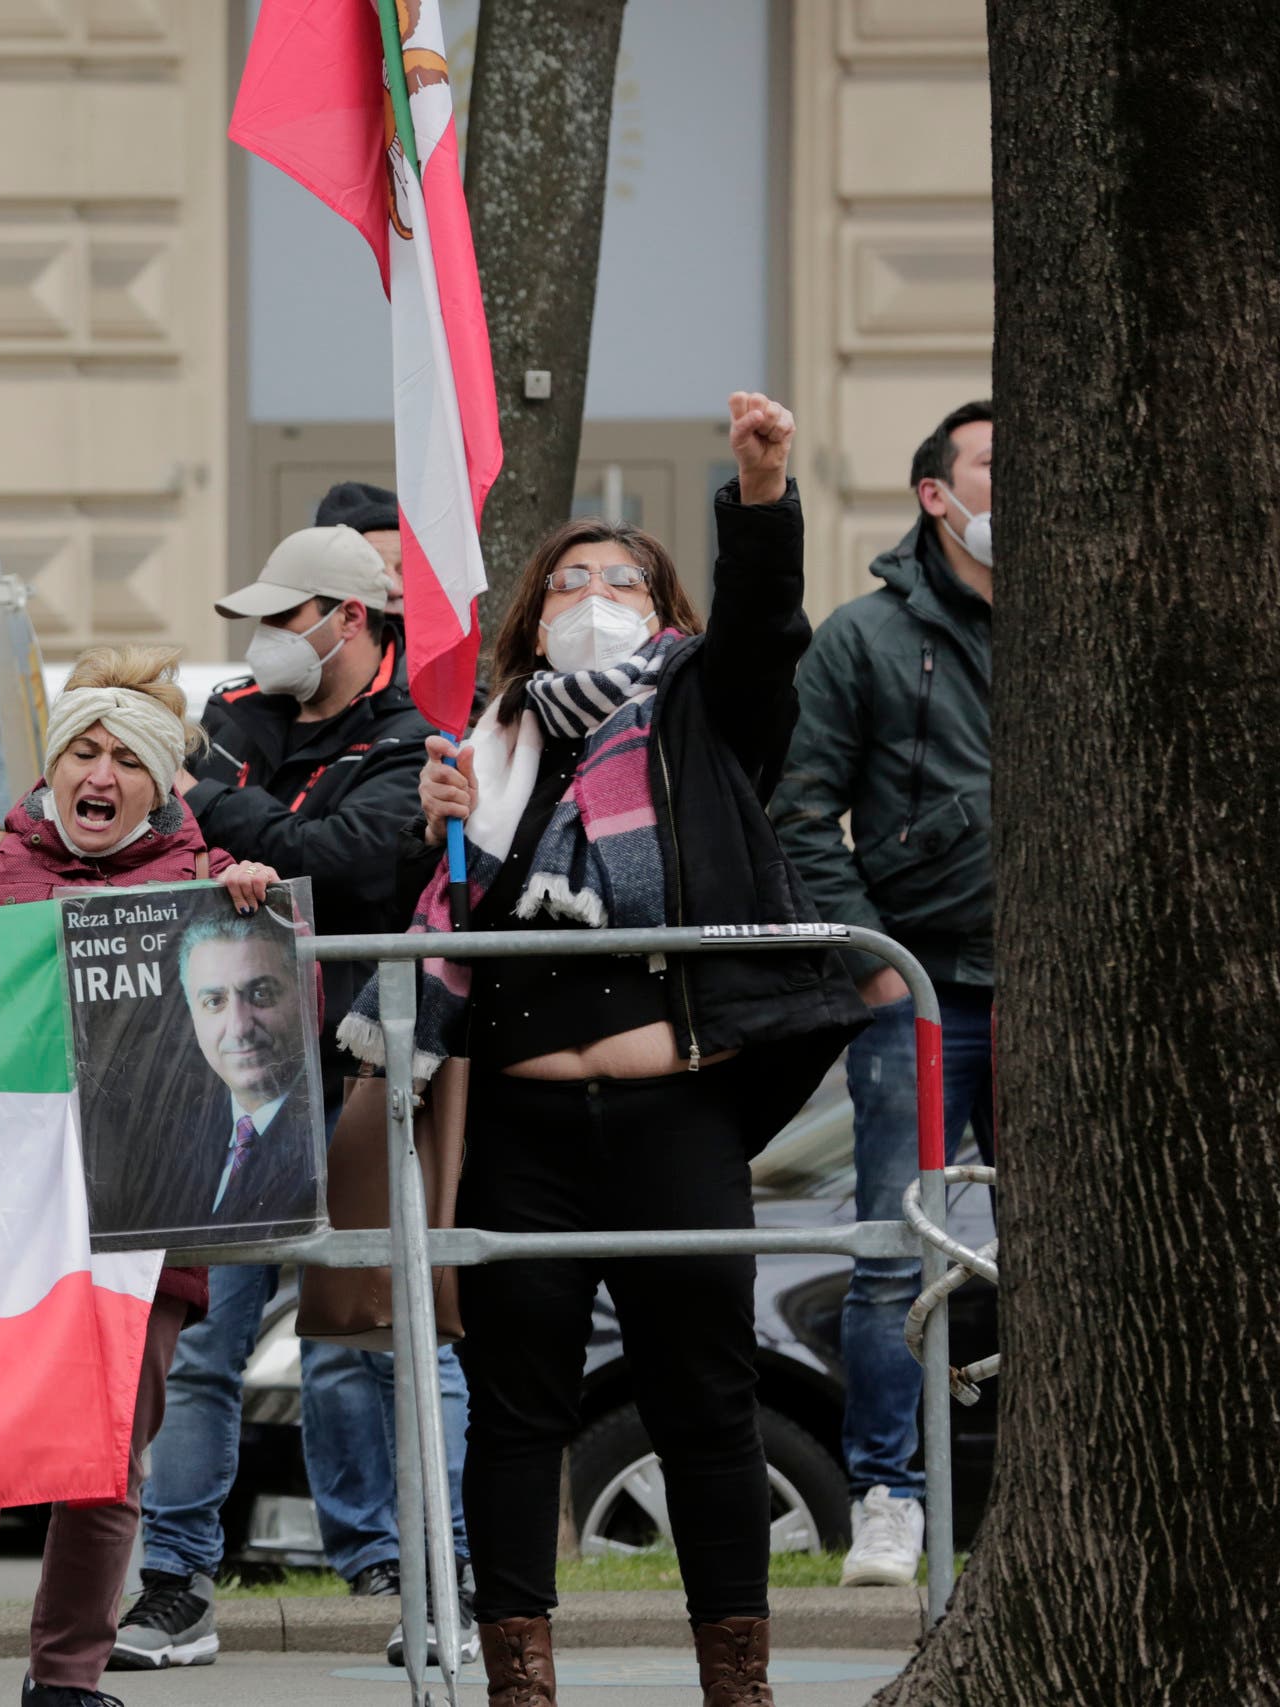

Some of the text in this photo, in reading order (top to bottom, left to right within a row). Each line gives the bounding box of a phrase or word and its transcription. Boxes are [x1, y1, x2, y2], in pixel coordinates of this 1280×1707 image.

[67, 903, 179, 929] Reza Pahlavi
[71, 933, 167, 958] KING OF
[73, 961, 163, 1003] IRAN
